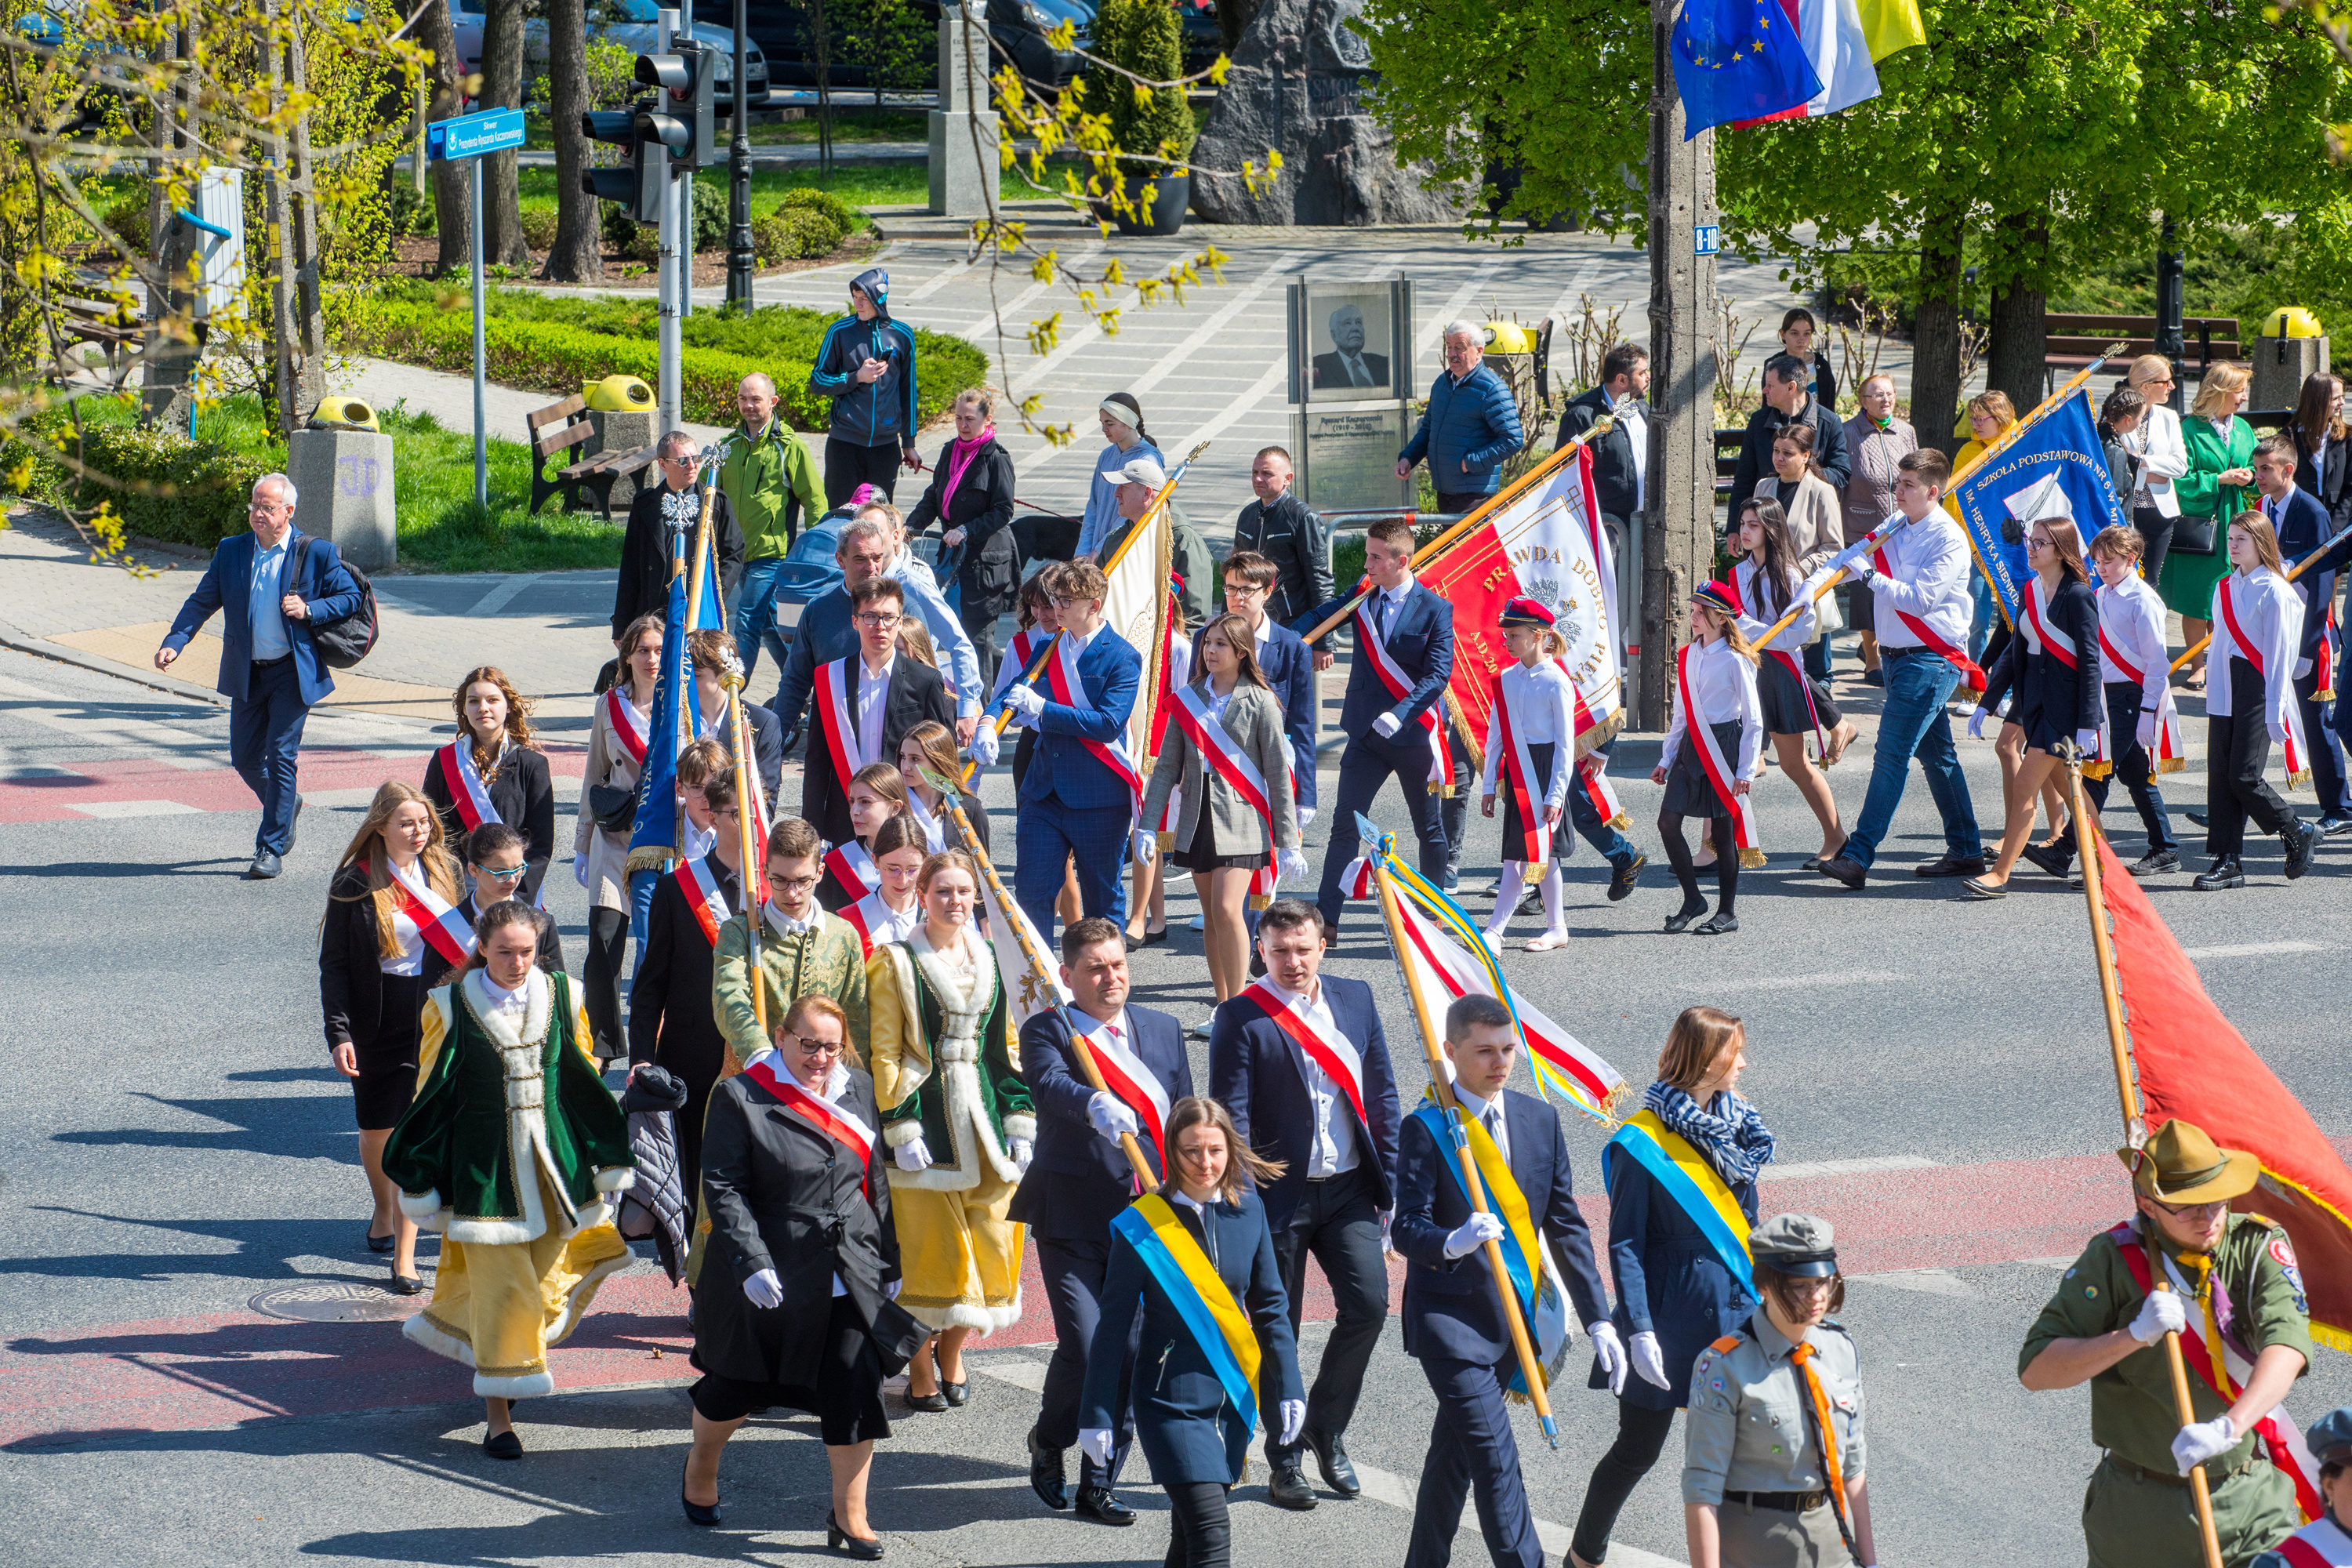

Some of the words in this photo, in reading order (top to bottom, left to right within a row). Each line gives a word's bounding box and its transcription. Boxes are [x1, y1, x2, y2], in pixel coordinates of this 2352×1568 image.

[458, 137, 477, 151] Prezydenta
[478, 133, 495, 148] Ryszarda
[494, 129, 522, 142] Kaczorowskiego
[483, 122, 498, 130] Skwer
[1696, 228, 1718, 251] 8-10
[1976, 462, 2016, 492] SZKOŁA
[2018, 449, 2092, 469] PODSTAWOWA
[2092, 463, 2107, 482] NR
[2103, 481, 2111, 490] 6
[1965, 488, 1976, 506] IM.
[1970, 506, 1998, 562] HENRYKA
[1483, 545, 1562, 593] PRAWDA
[1995, 560, 2020, 608] SIENKIE
[1571, 557, 1607, 630] DOBRO
[1470, 631, 1498, 673] A.D.20
[1569, 641, 1606, 689] PIĘK
